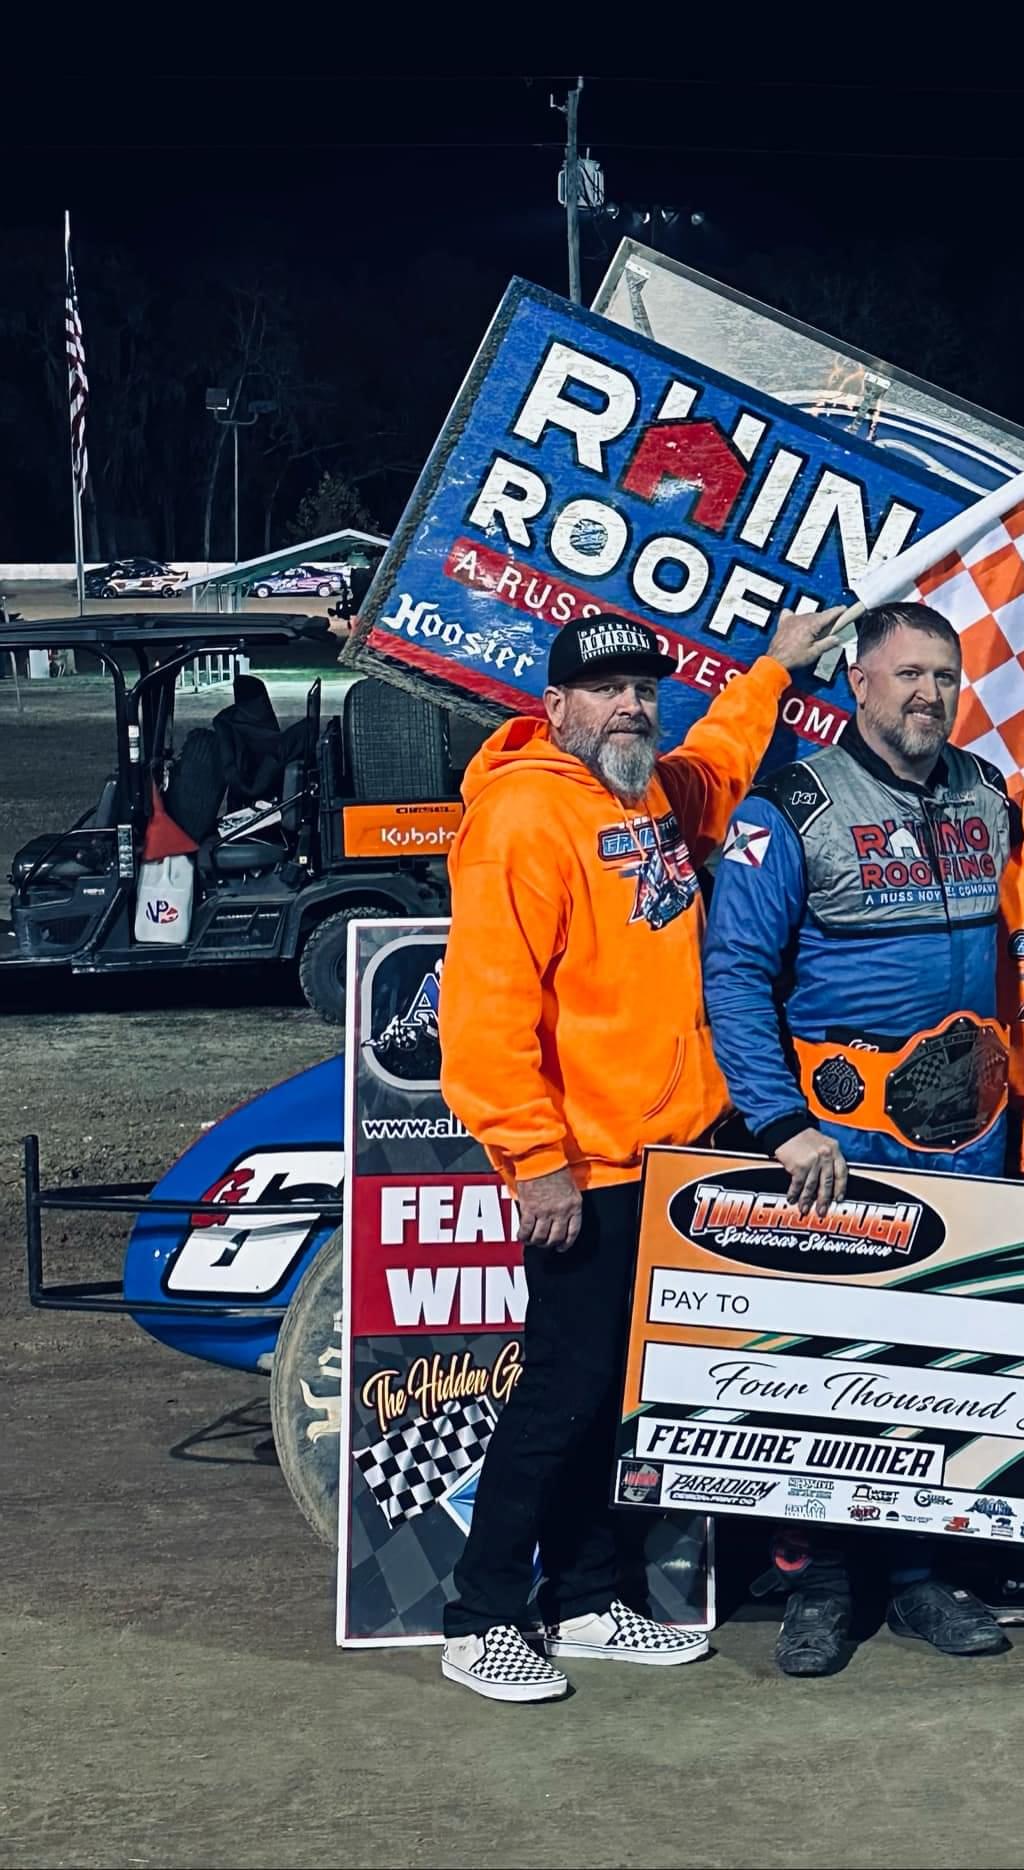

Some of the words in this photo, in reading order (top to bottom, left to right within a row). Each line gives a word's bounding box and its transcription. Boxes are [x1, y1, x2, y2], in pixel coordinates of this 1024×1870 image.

[453, 550, 478, 580] A
[381, 593, 535, 678] Hoosier
[880, 891, 914, 905] RUSS
[692, 1186, 754, 1233] TIM
[715, 1226, 798, 1248] Sprintcar
[799, 1233, 893, 1257] Showdown
[660, 1289, 708, 1311] PAY
[716, 1293, 750, 1314] TO
[362, 1369, 407, 1433] The
[407, 1352, 489, 1418] Hidden
[708, 1360, 809, 1401] Four
[823, 1371, 1017, 1420] Thousand
[647, 1424, 802, 1465] FEATURE
[805, 1438, 935, 1479] WINNER
[665, 1472, 781, 1501] PARADIGM
